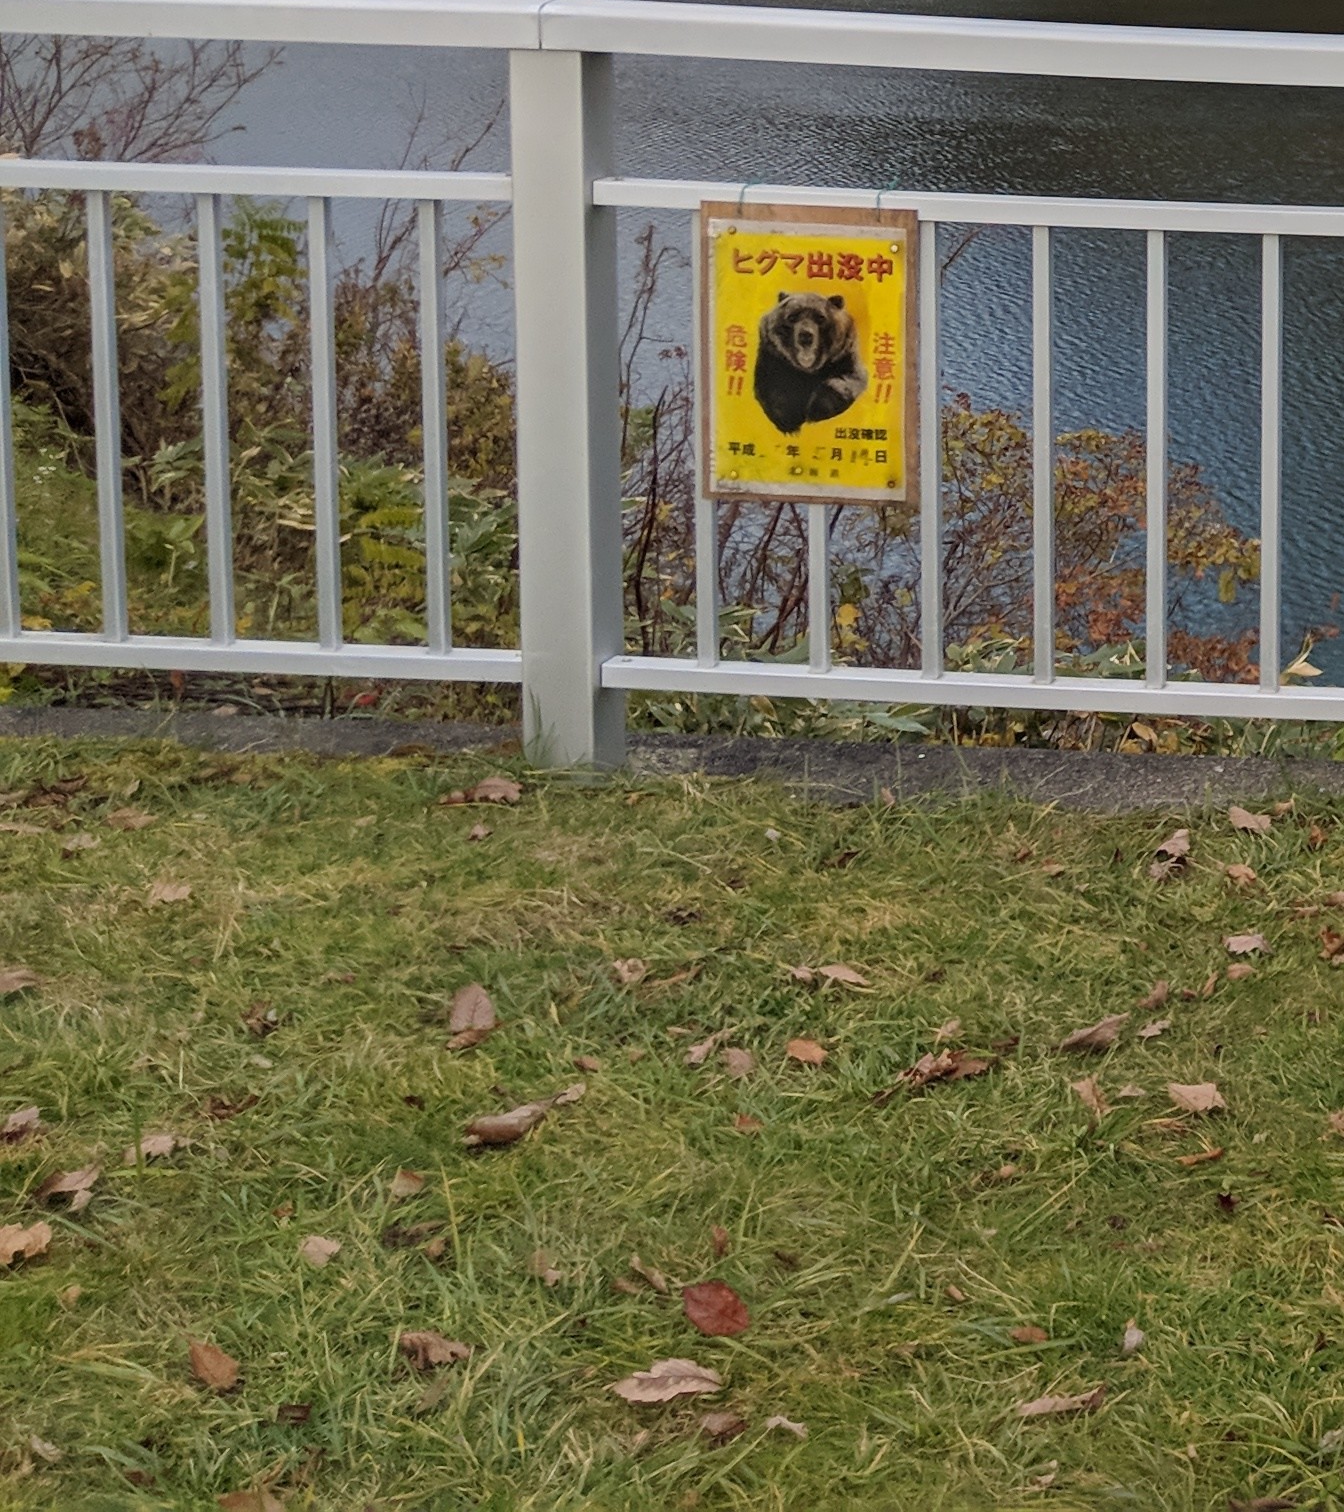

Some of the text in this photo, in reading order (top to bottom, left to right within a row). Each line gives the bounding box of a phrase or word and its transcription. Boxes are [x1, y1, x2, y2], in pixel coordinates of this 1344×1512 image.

[732, 248, 893, 283] ヒグマ出没中
[835, 427, 888, 441] 出没確認
[728, 441, 756, 456] 平成
